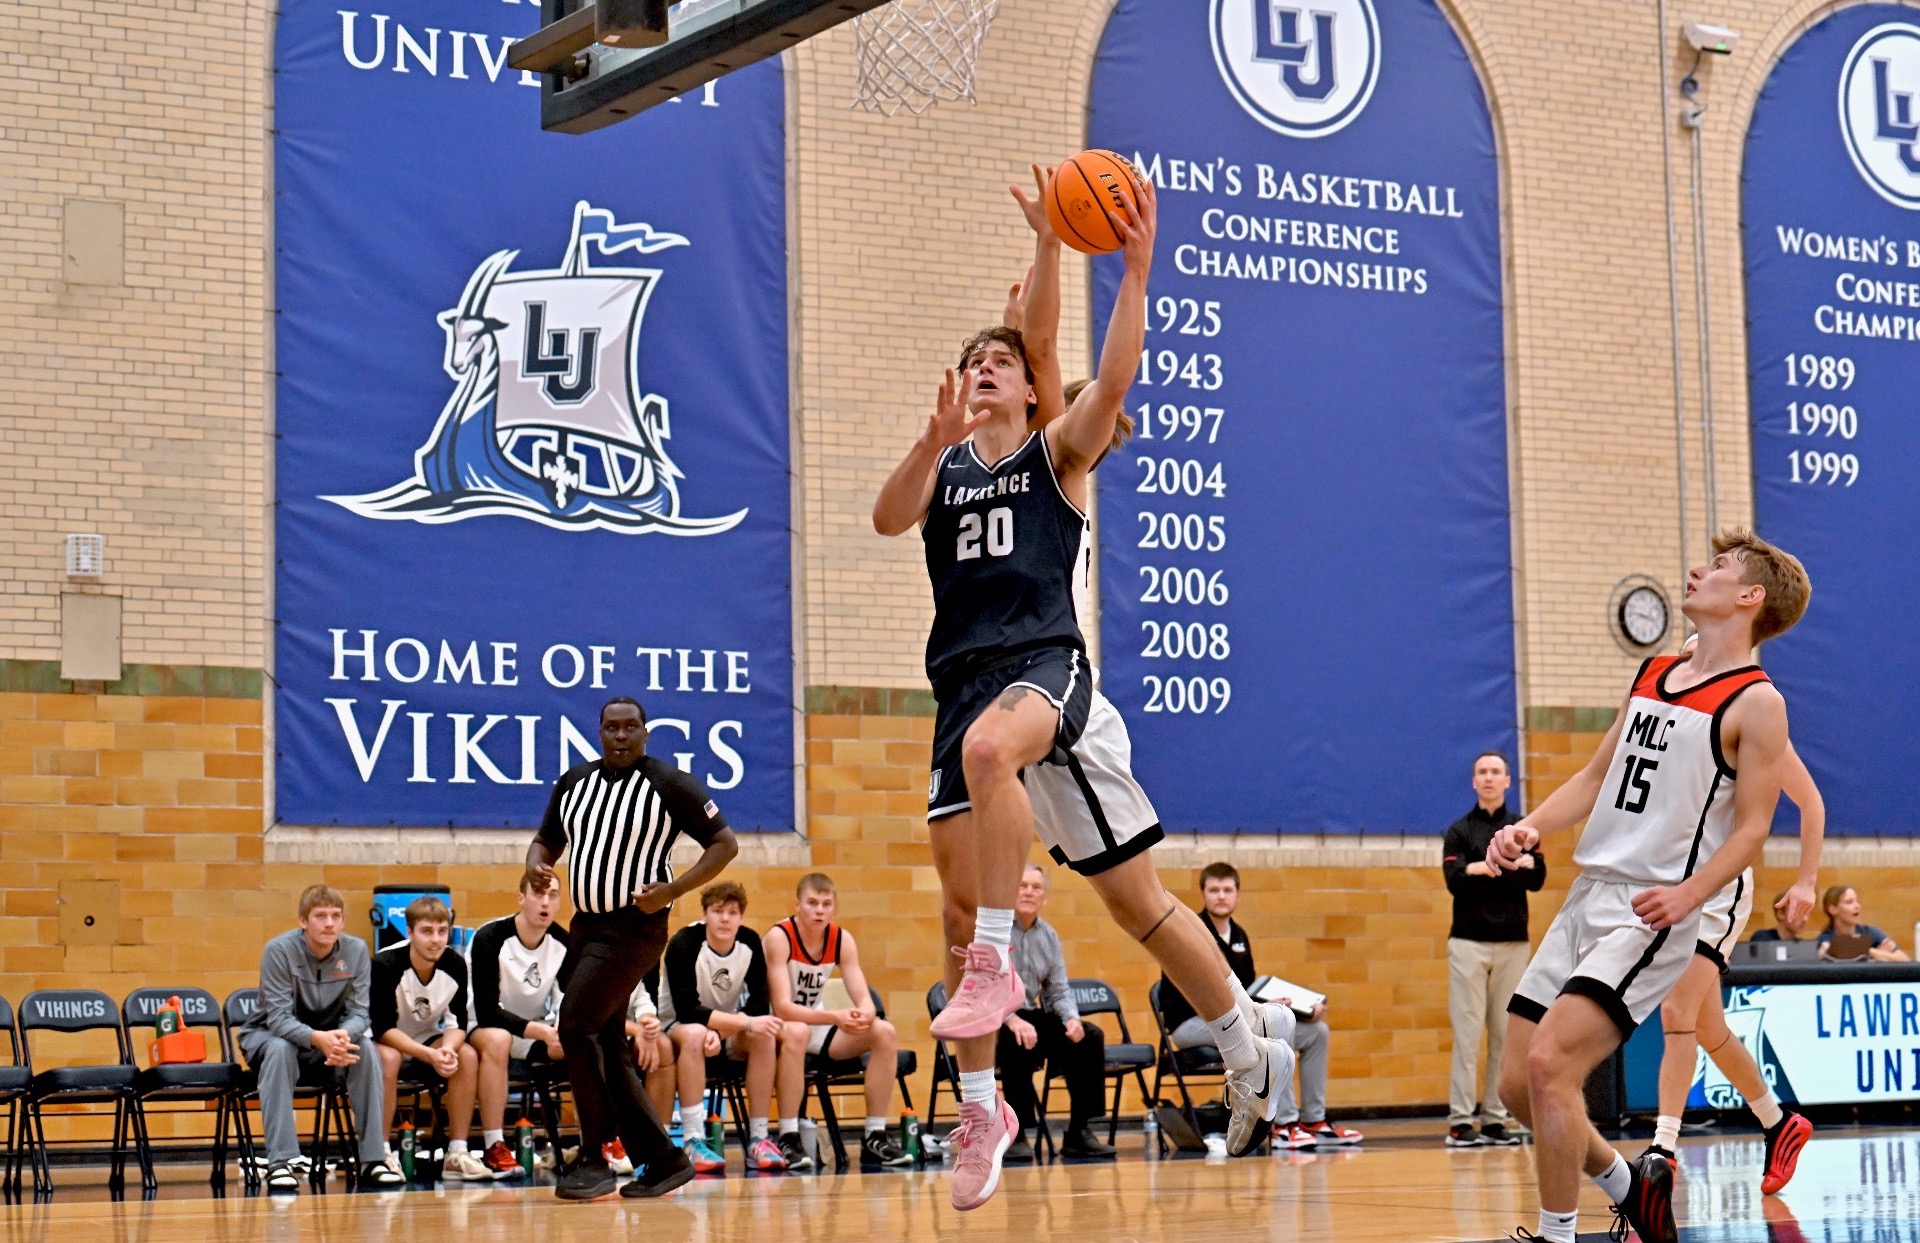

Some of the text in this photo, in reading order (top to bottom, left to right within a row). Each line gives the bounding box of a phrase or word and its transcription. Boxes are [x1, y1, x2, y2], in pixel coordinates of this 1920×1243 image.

[1133, 151, 1241, 196] MEN'S
[1256, 164, 1463, 218] BASKETBALL
[1202, 209, 1400, 255] CONFERENCE
[1776, 225, 1898, 266] WOMEN'S
[1175, 245, 1428, 294] CHAMPIONSHIPS
[1144, 295, 1222, 337] 1925
[522, 301, 602, 405] LU
[1138, 348, 1224, 390] 1943
[1784, 353, 1856, 391] 1989
[1137, 402, 1225, 444] 1997
[1786, 401, 1858, 439] 1990
[1136, 457, 1227, 497] 2004
[1788, 450, 1859, 487] 1999
[956, 506, 1014, 562] 20
[1137, 511, 1226, 552] 2005
[1139, 566, 1229, 606] 2006
[1140, 620, 1231, 660] 2008
[328, 629, 751, 693] HOME OF THE
[1142, 675, 1231, 714] 2009
[1626, 711, 1675, 752] MLC
[1614, 755, 1658, 814] 15
[797, 970, 824, 989] MLC
[35, 999, 105, 1018] VIKINGS
[138, 997, 207, 1015] VIGS
